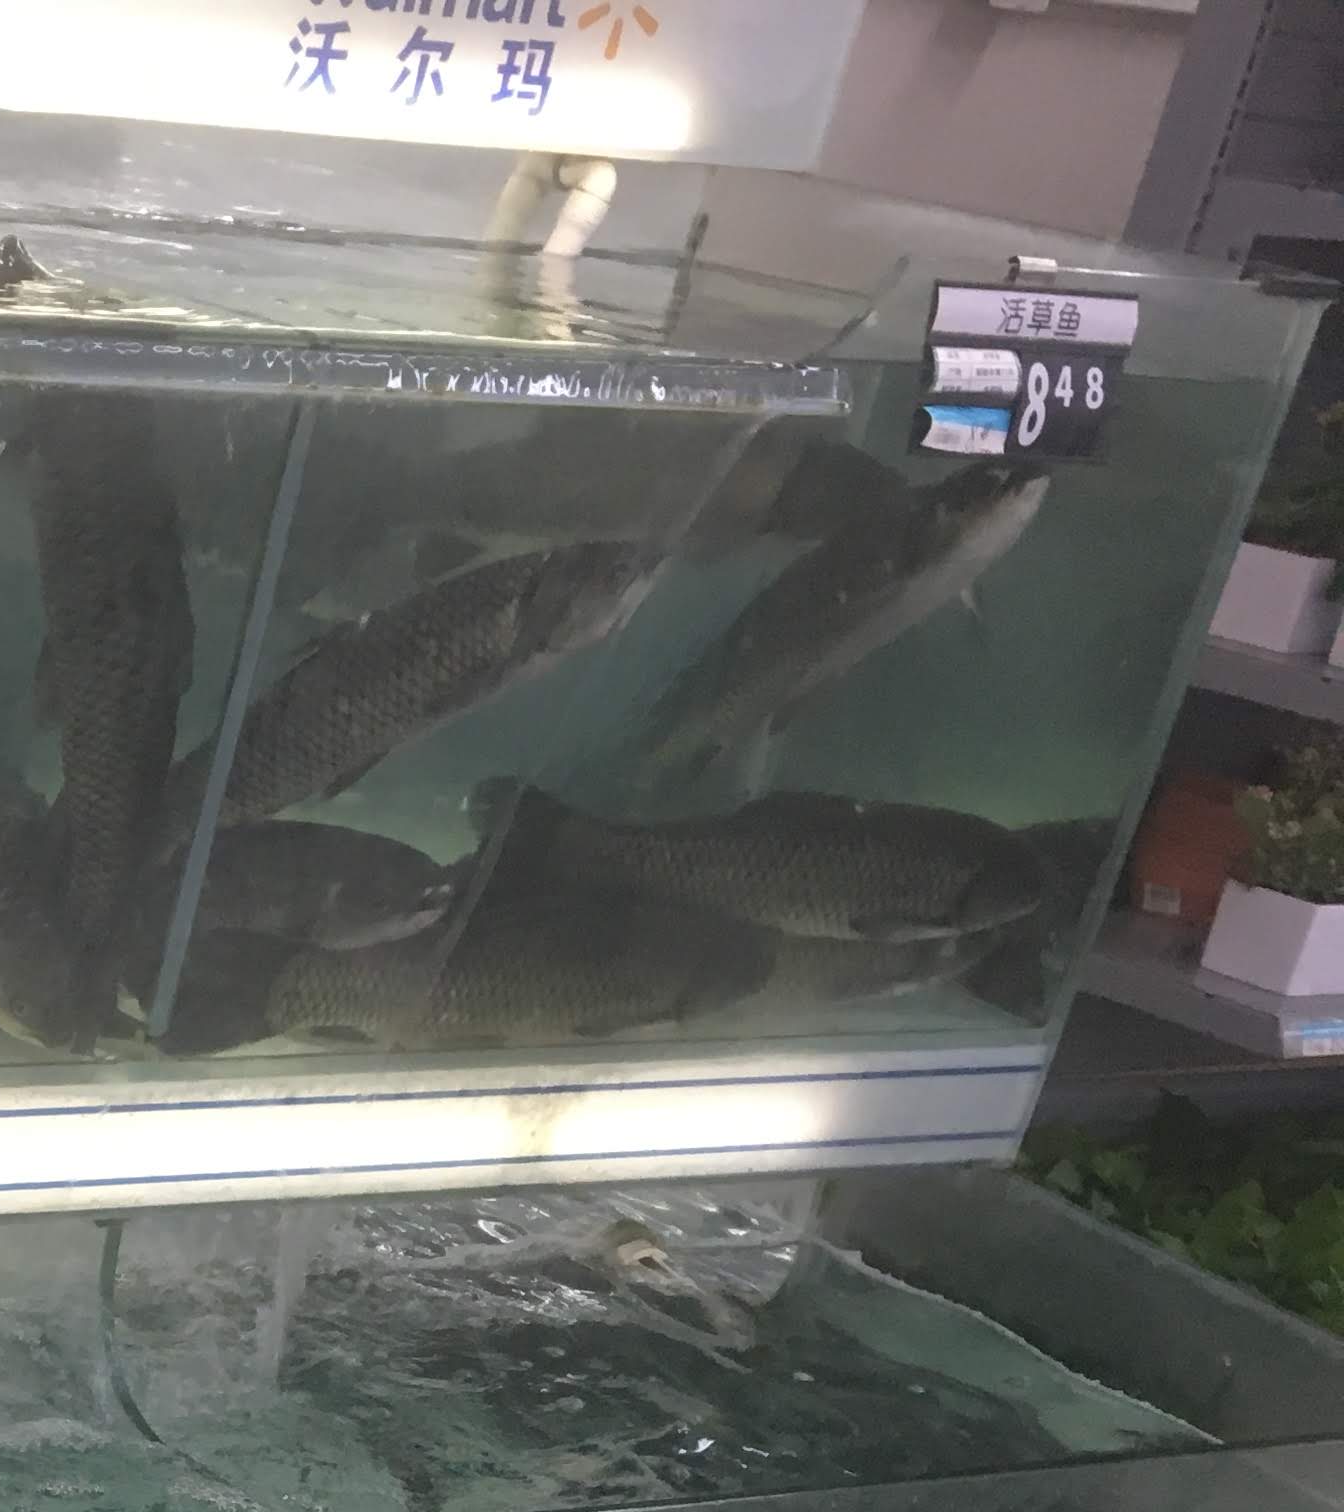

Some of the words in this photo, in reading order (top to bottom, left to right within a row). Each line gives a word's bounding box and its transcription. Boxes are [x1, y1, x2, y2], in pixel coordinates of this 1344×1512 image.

[283, 16, 558, 115] 沃尔玛
[997, 297, 1081, 337] 活草鱼
